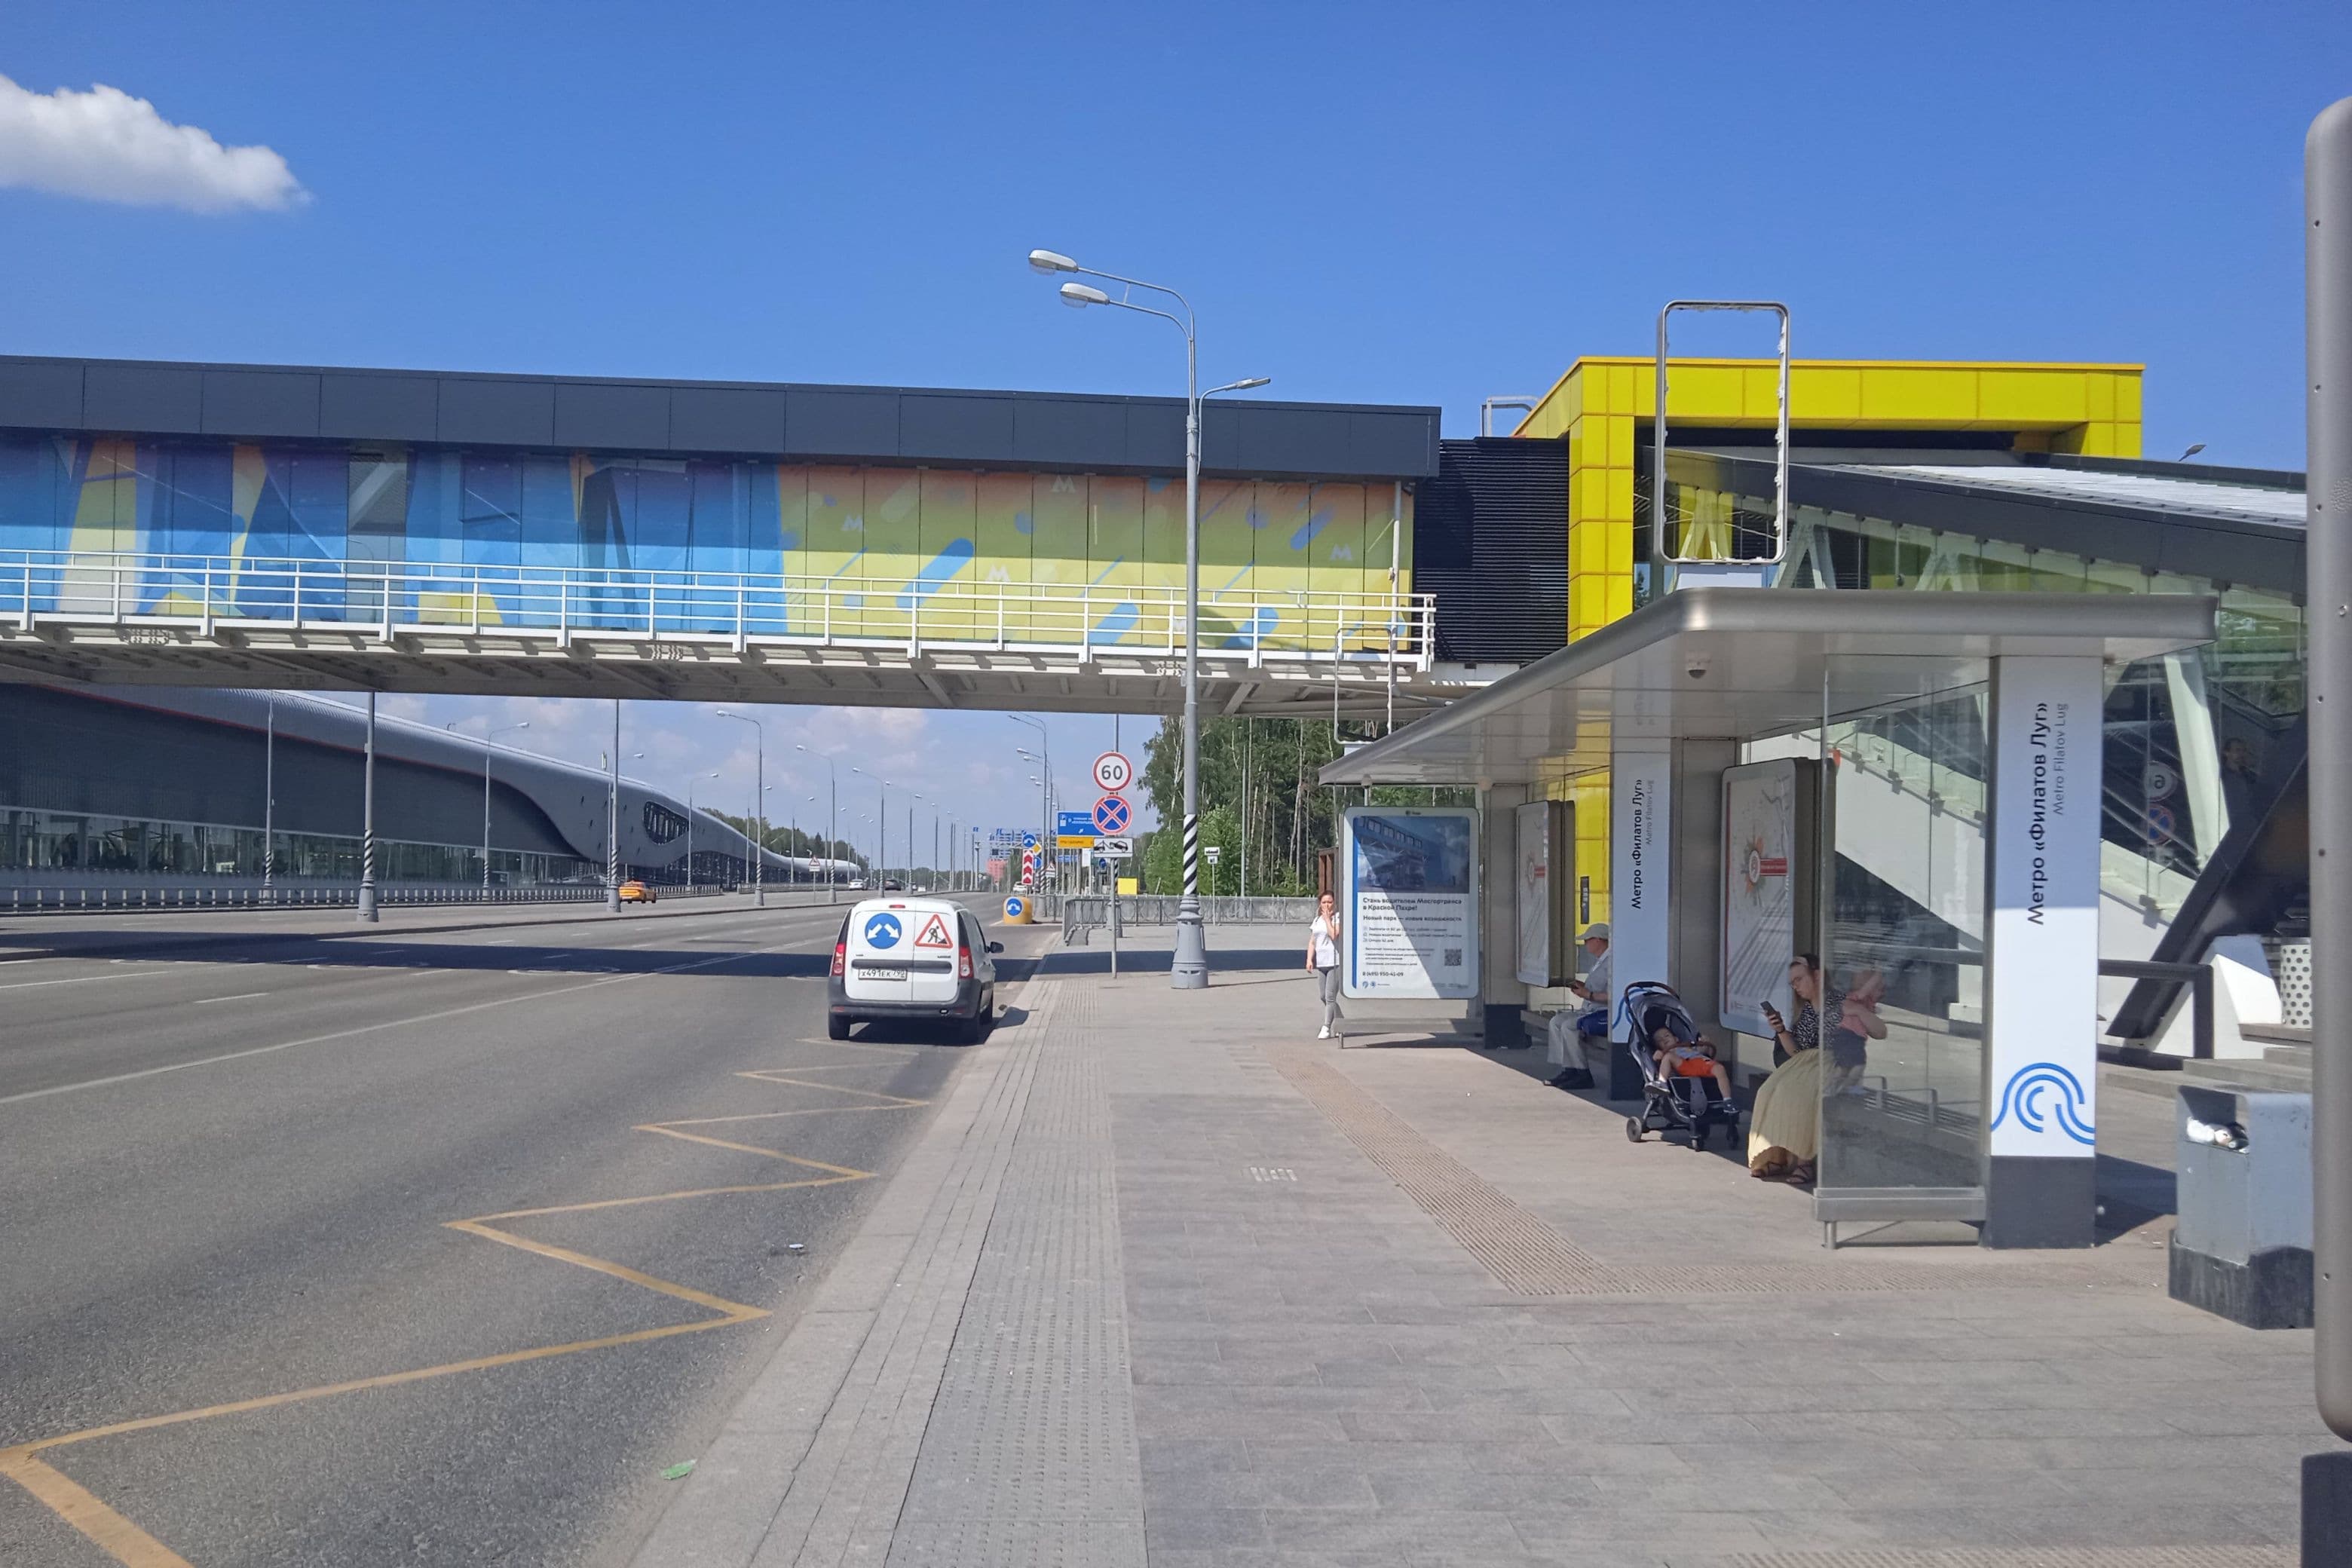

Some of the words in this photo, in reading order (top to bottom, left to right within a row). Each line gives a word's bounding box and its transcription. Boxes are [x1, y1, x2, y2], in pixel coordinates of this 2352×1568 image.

[2030, 703, 2050, 749] Луг»
[2055, 703, 2069, 726] Lug
[2053, 730, 2066, 771] Filatov
[1101, 764, 1122, 780] 60
[1632, 779, 1644, 806] Луг»
[2029, 754, 2047, 851] «Филатов
[2053, 776, 2064, 816] Metro
[1631, 809, 1642, 866] «Филатов
[1631, 869, 1643, 909] Метро
[2028, 856, 2048, 926] Метро
